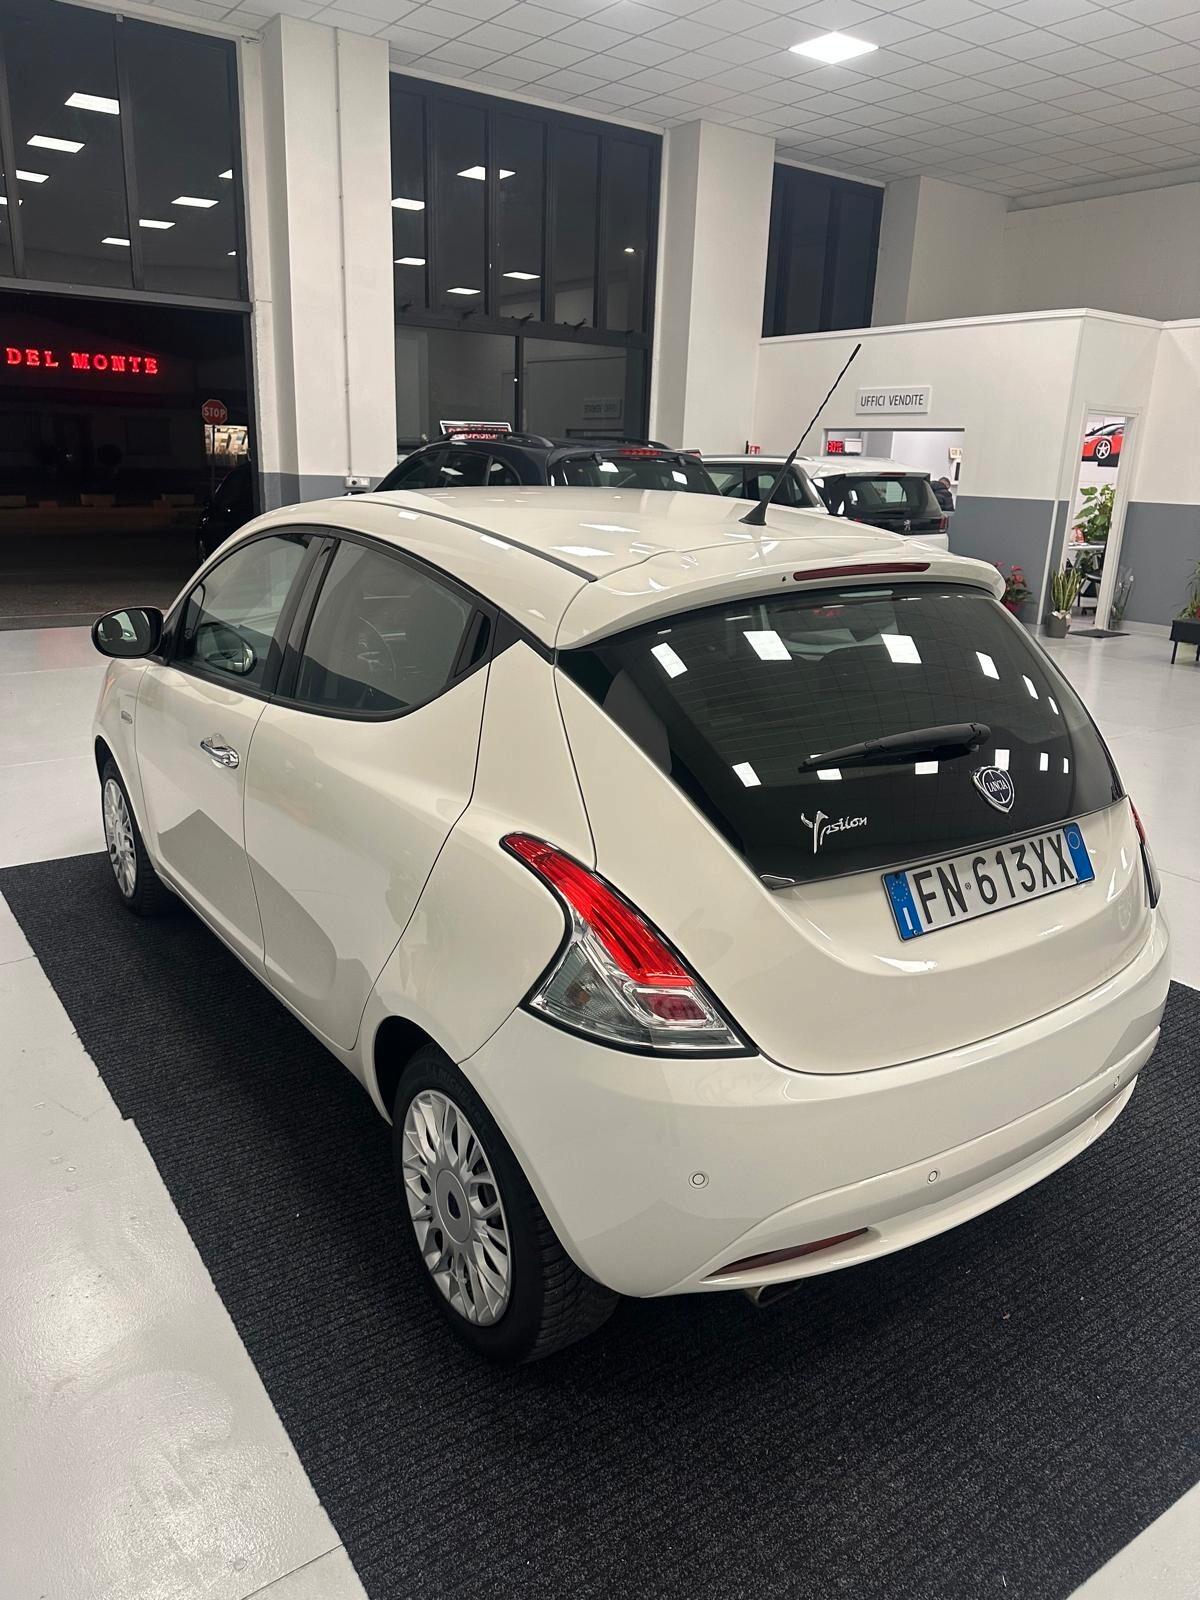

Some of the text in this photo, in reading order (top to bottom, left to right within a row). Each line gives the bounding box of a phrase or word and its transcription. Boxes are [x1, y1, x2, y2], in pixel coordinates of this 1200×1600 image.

[6, 347, 159, 375] DEL MONTE
[861, 394, 924, 407] UFFICI VENDITE
[204, 406, 226, 418] STOP
[986, 779, 1008, 793] LANCIA
[800, 810, 868, 854] Ypsilon
